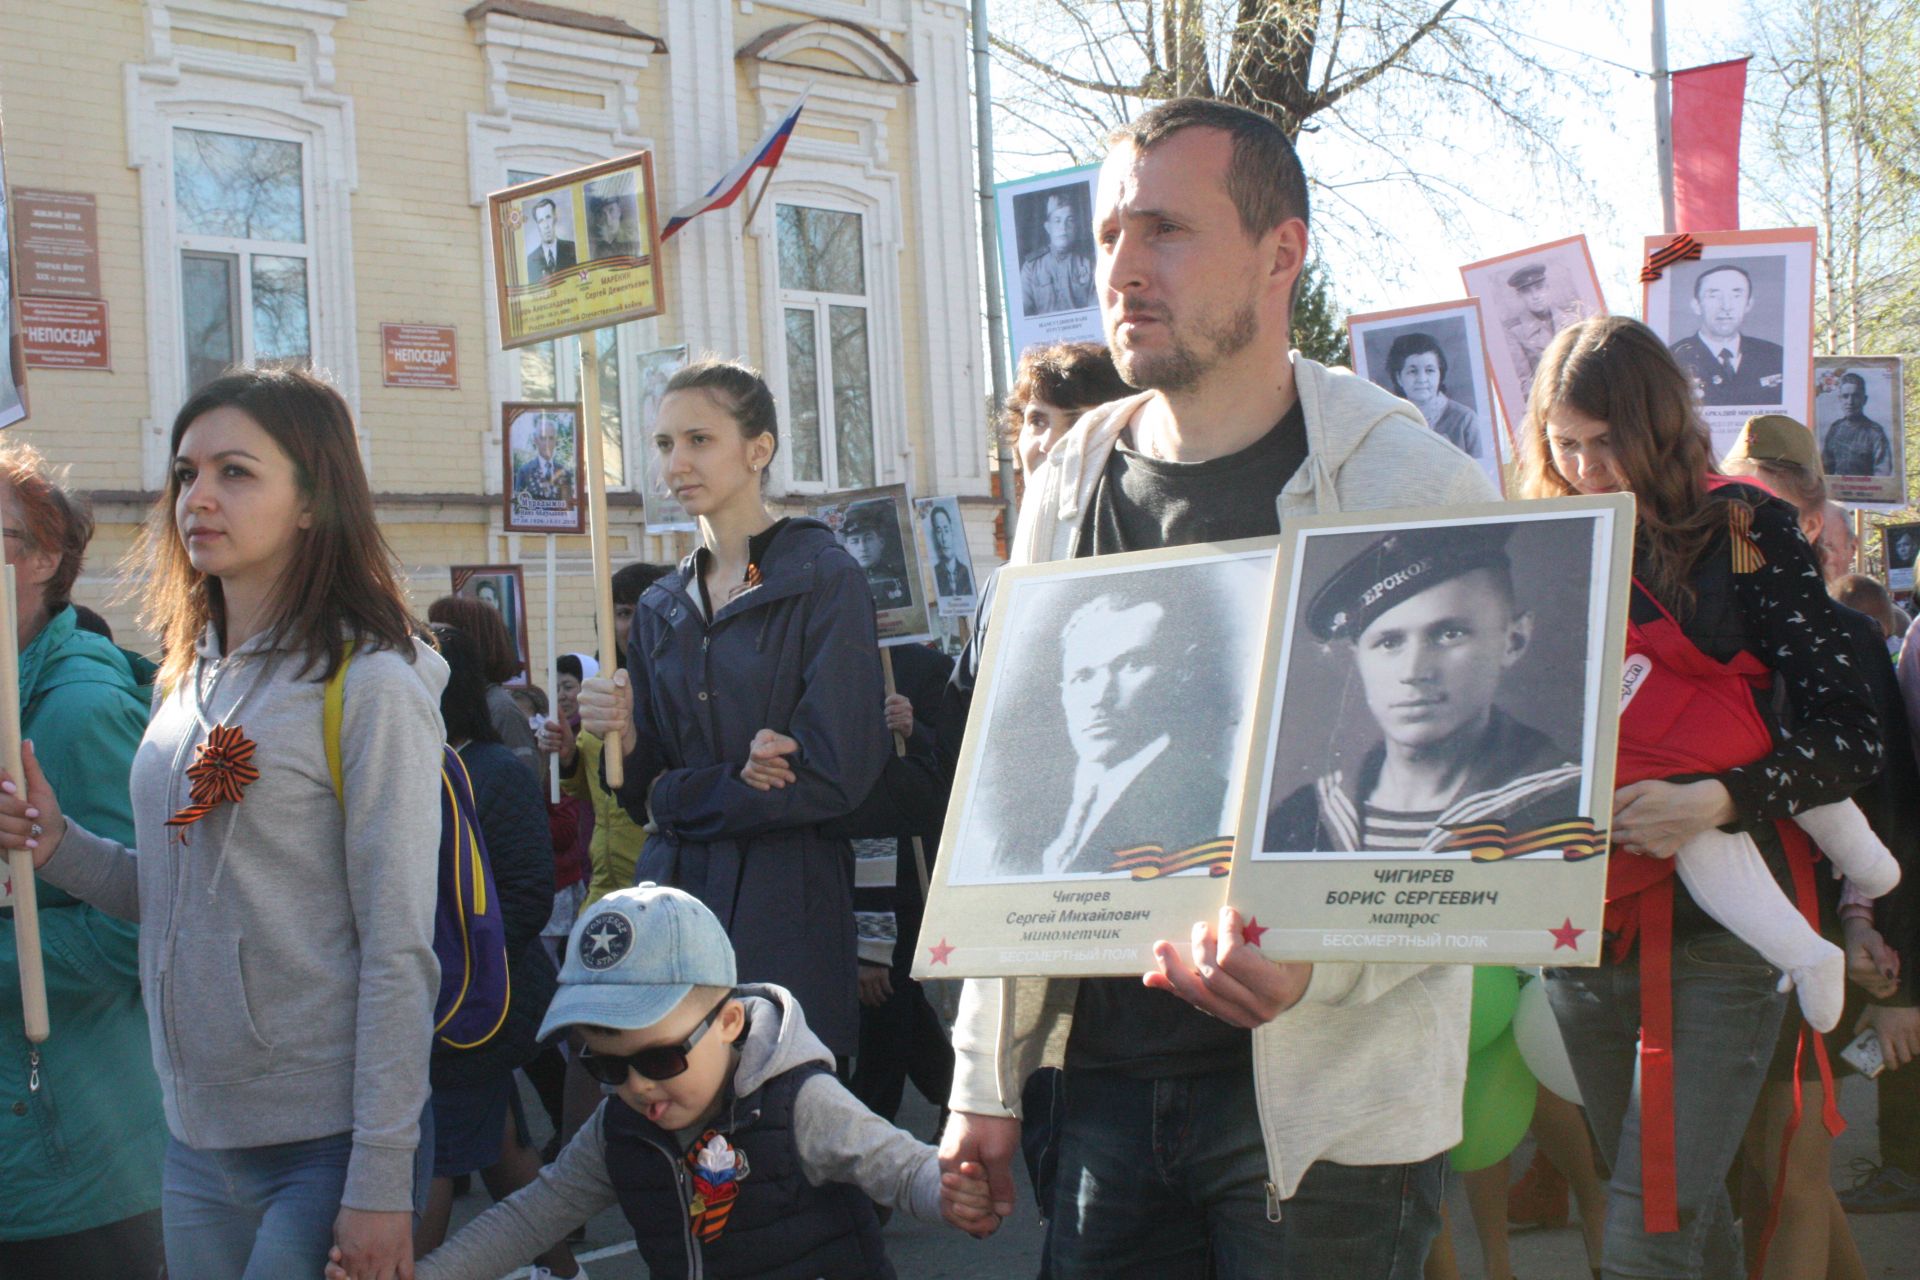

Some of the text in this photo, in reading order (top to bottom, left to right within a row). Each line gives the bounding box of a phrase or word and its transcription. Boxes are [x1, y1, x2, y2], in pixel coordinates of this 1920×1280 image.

[1374, 869, 1454, 883] ЧИГИРЕВ
[1053, 890, 1111, 905] Чигирев
[1326, 891, 1498, 905] БОРИС СЕРГЕЕВИЧ
[1006, 908, 1151, 926] Сергей Михайлович
[1369, 912, 1440, 928] матрос
[586, 916, 627, 935] CONVERSE
[1019, 928, 1121, 942] минометчик
[1322, 932, 1488, 948] БЕССМЕРТНЫЙ ПОЛК
[597, 951, 619, 966] STAR
[1000, 947, 1138, 963] БЕССМЕРТНЫЙ ПОЛК
